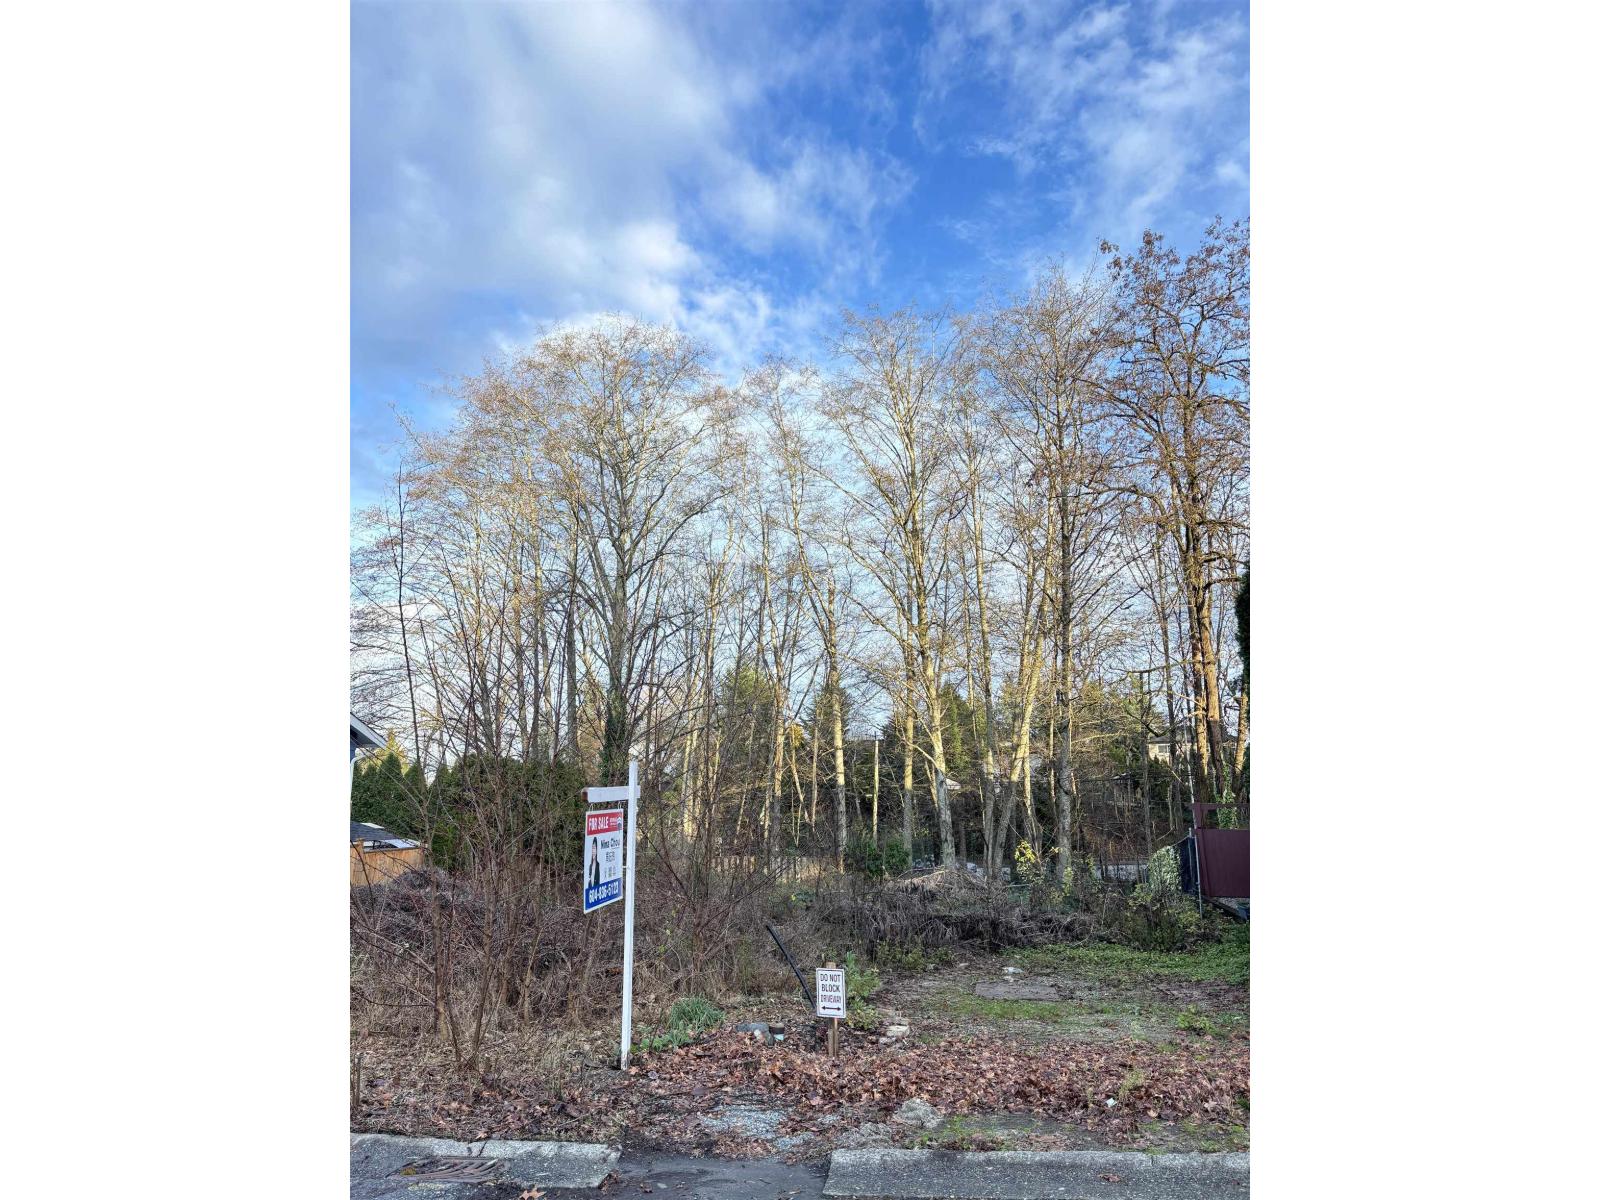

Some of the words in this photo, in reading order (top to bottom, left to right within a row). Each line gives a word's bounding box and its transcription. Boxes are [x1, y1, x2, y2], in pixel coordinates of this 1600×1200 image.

[588, 817, 598, 831] FOR
[598, 816, 608, 830] SALE
[830, 974, 841, 982] NOT
[822, 984, 840, 992] BLOCK
[821, 994, 841, 1003] DRIVEWAY
